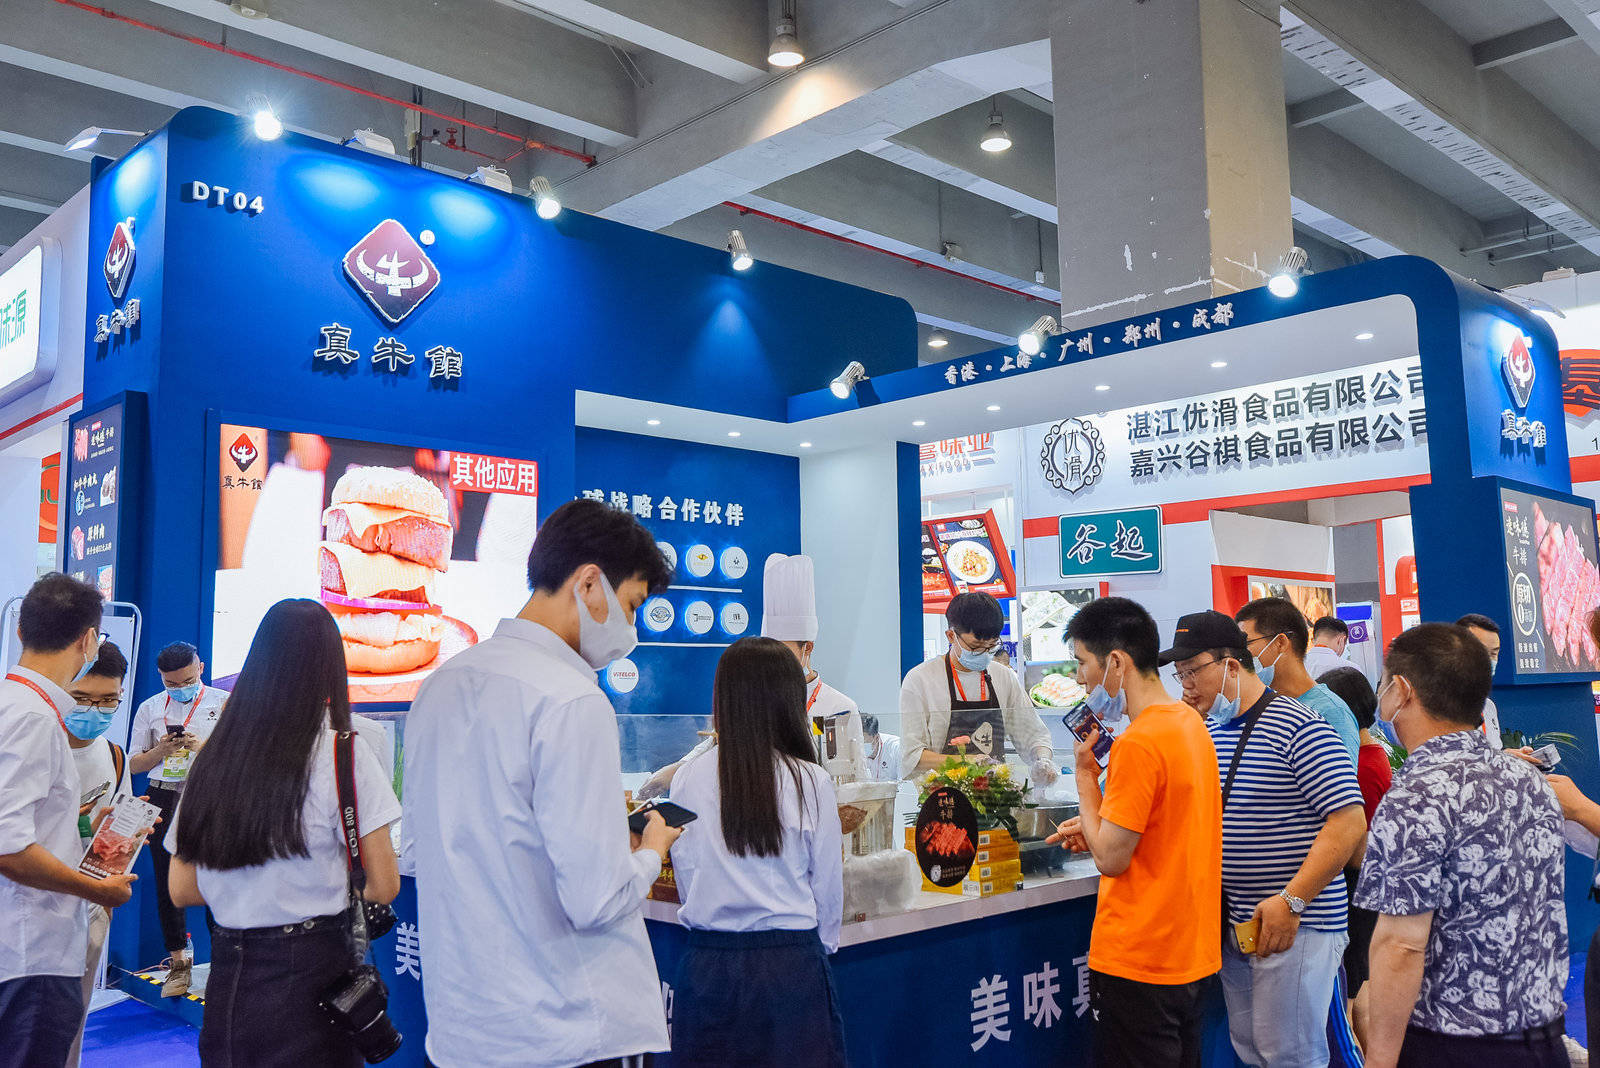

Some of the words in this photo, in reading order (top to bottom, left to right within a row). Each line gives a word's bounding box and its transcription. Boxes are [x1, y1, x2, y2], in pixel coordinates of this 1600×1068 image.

[192, 180, 264, 214] DT04
[944, 361, 979, 385] 香港
[1000, 350, 1033, 373] 上海
[1058, 332, 1094, 363] 广州
[1121, 318, 1163, 348] 郑州
[1191, 302, 1235, 330] 成都
[452, 453, 536, 494] 其他应用
[574, 489, 745, 527] 战略合作伙伴
